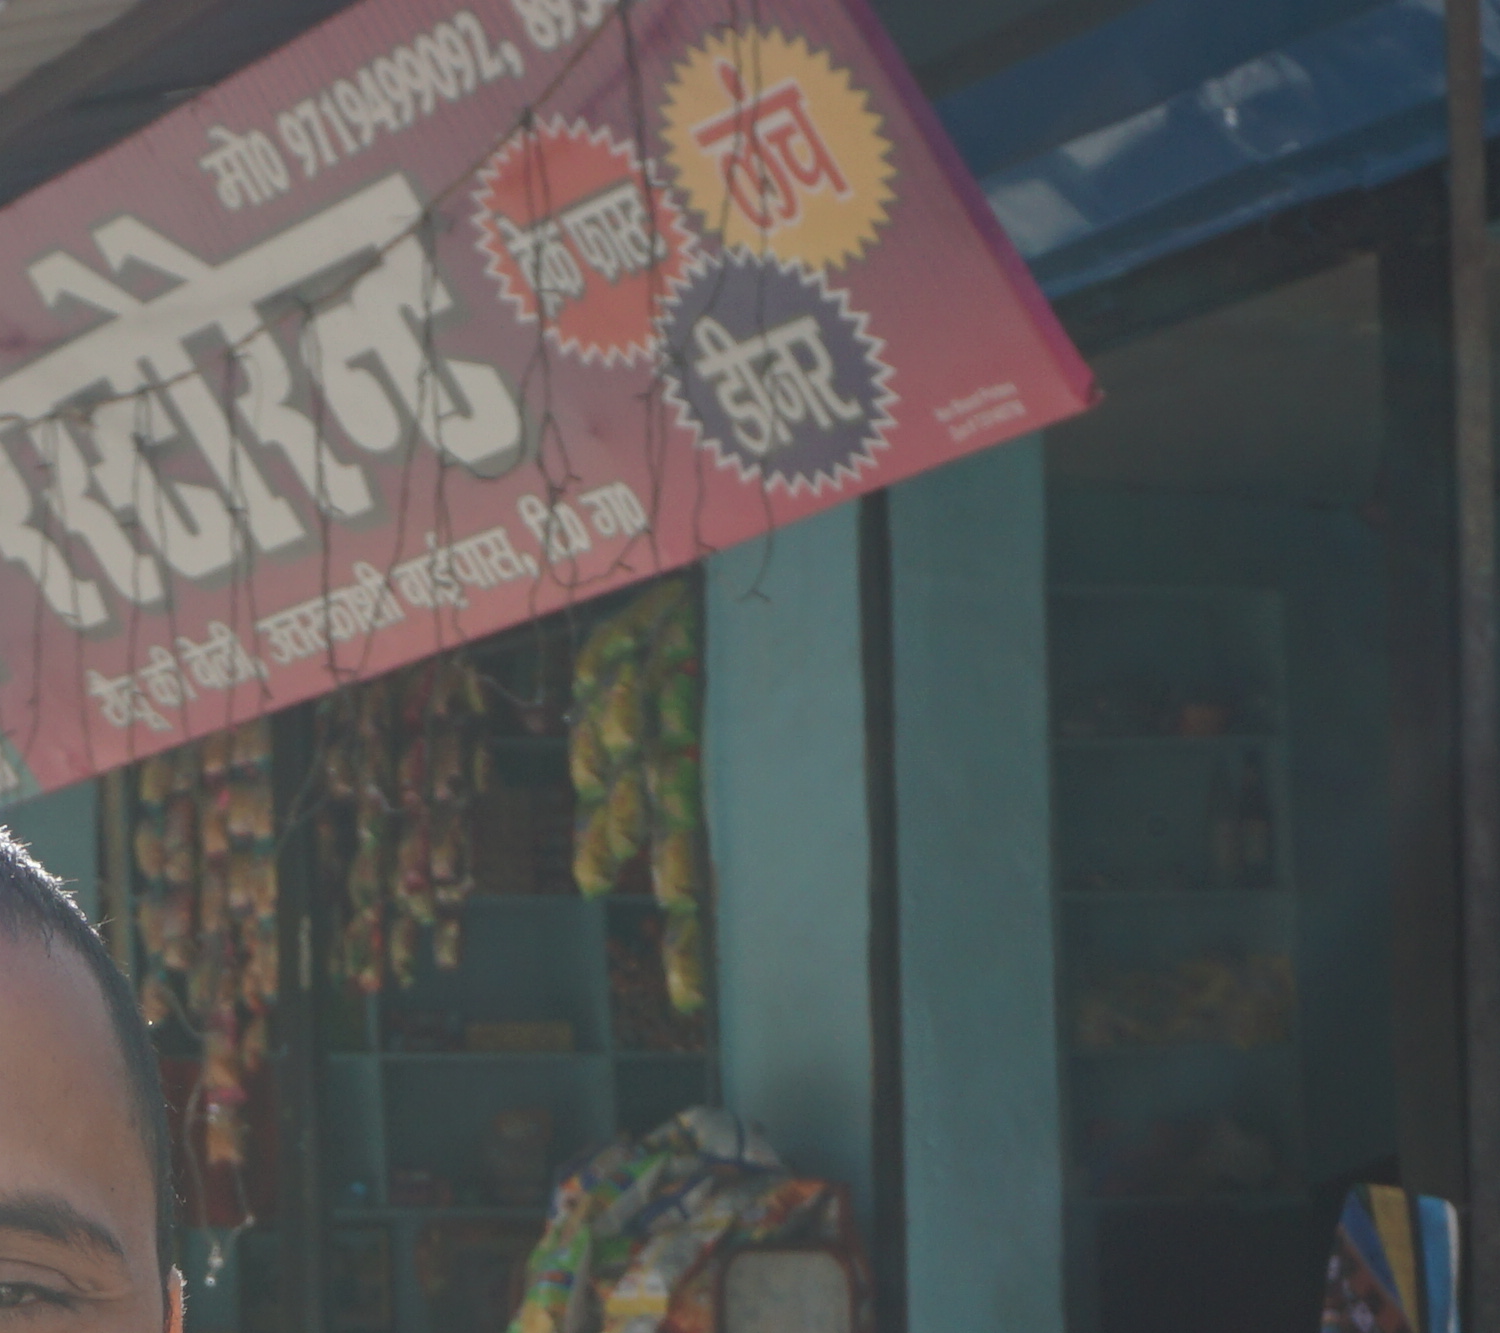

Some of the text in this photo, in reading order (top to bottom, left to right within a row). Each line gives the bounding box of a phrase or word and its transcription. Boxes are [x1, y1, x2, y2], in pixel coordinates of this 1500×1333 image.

[276, 11, 525, 179] 9719499092,
[690, 58, 852, 236] लंच
[694, 316, 861, 454] डीनर
[139, 643, 199, 709] की
